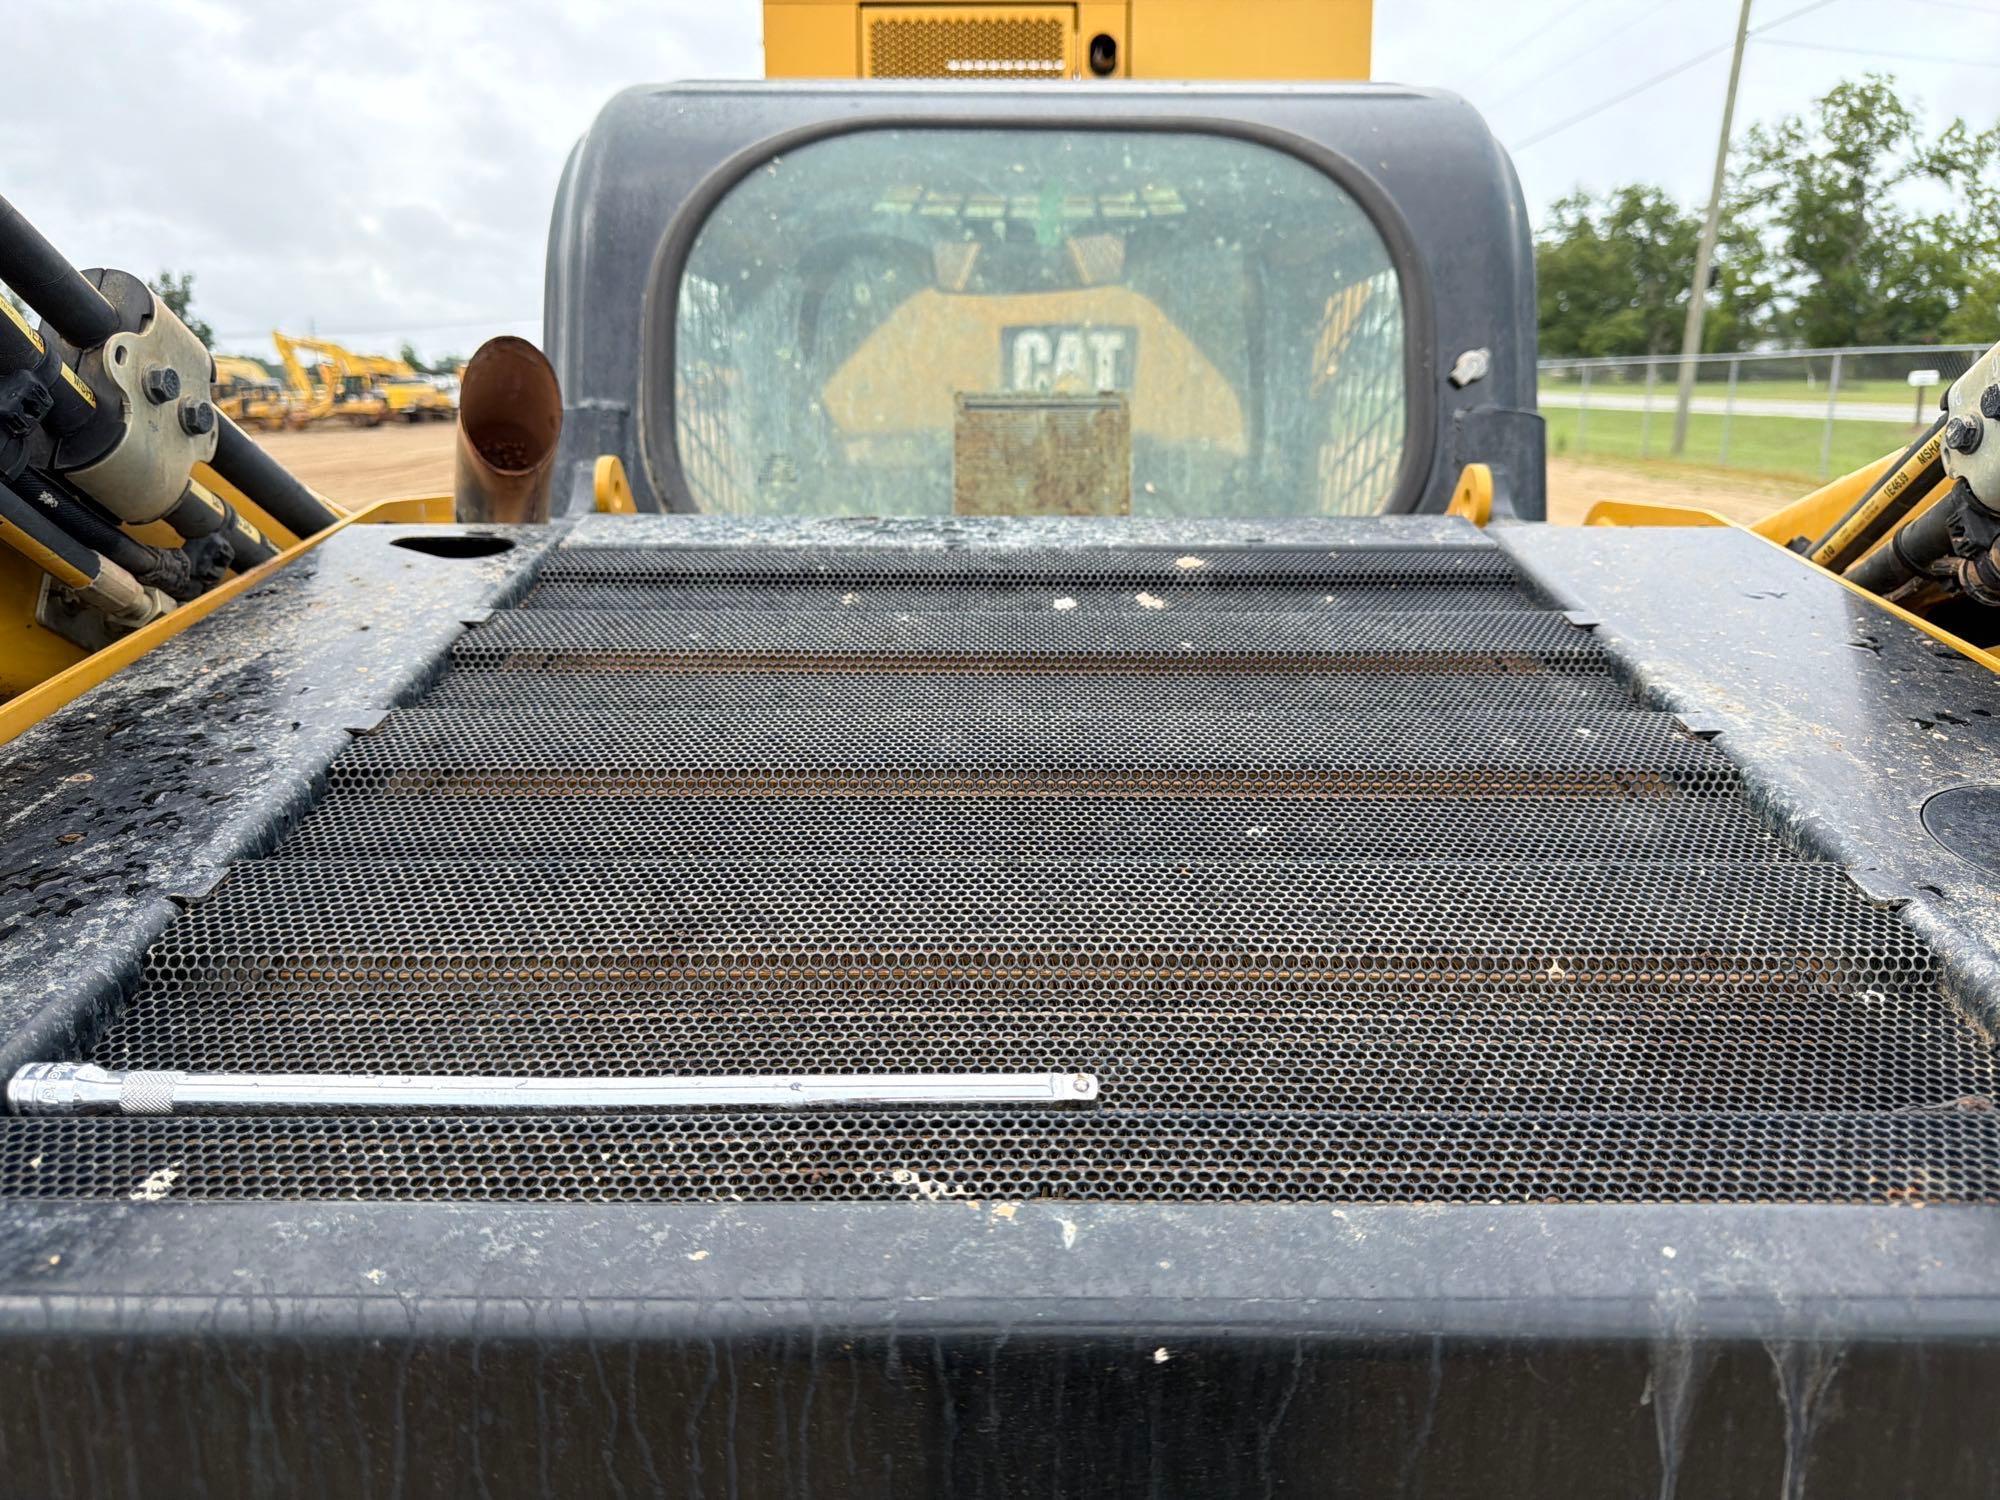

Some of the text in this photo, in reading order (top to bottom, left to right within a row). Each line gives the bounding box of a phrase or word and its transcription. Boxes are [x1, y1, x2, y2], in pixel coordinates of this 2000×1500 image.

[1012, 328, 1126, 392] CAT
[1883, 471, 1910, 499] 1E4639
[1916, 438, 1942, 466] MSHA
